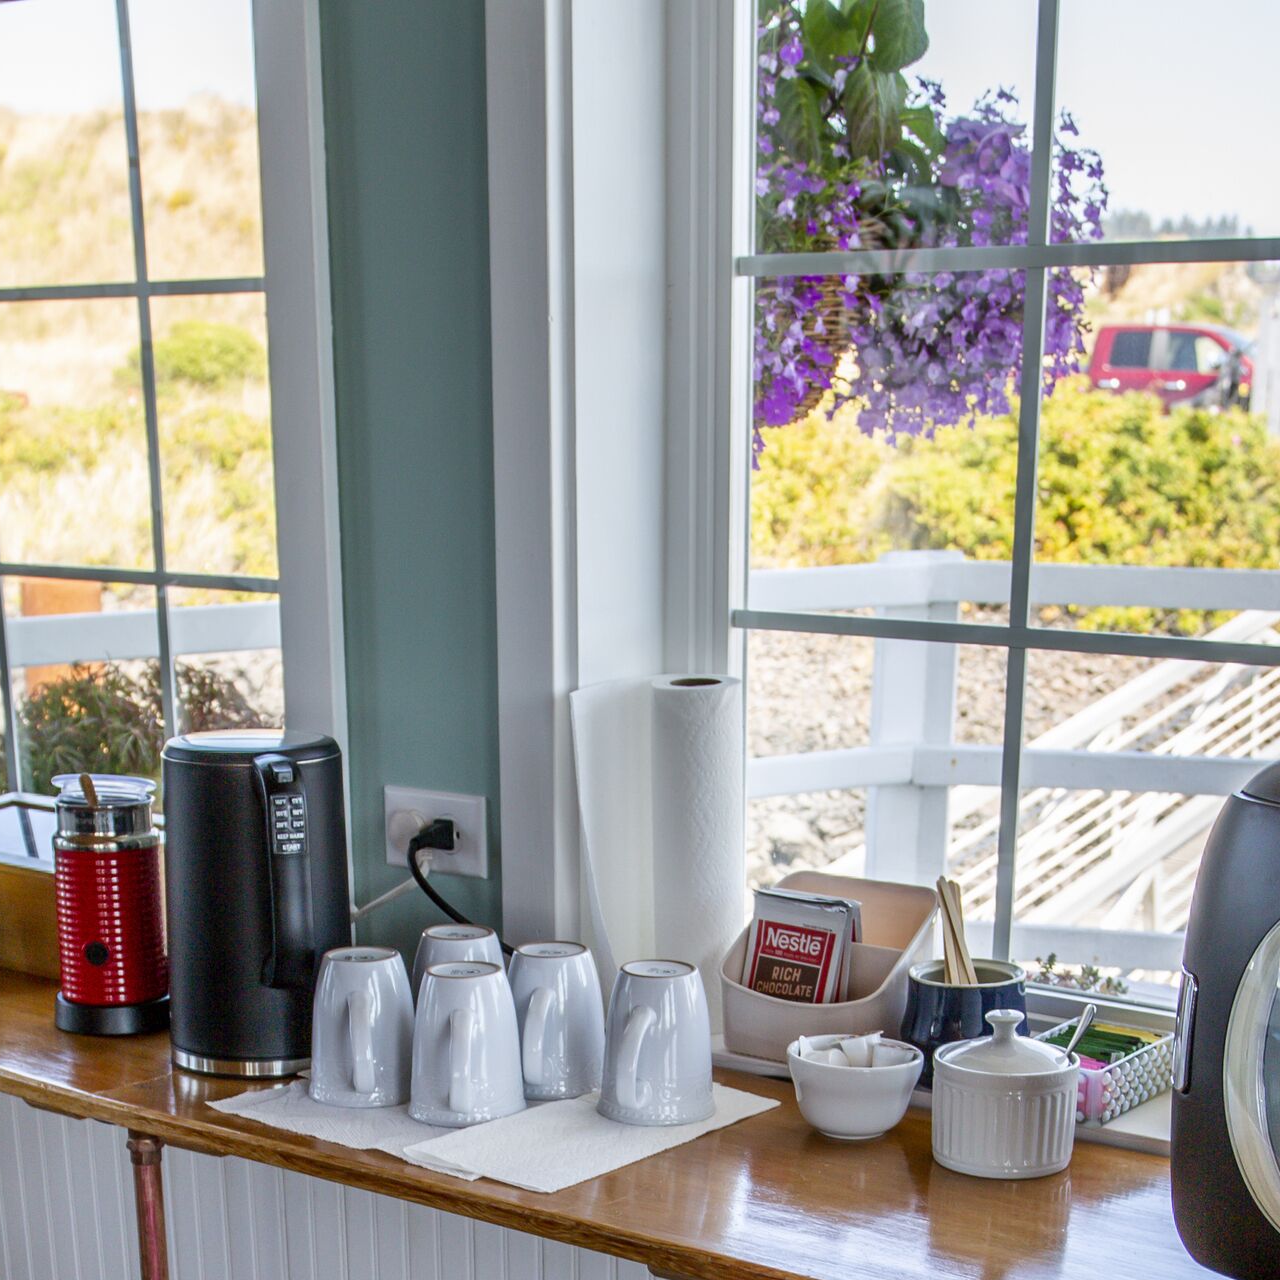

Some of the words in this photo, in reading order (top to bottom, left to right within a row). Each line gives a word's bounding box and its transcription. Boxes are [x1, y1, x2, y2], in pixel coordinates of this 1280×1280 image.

[765, 926, 823, 957] Nestlé
[771, 966, 802, 982] RICH
[756, 980, 813, 998] CHOCOLATE
